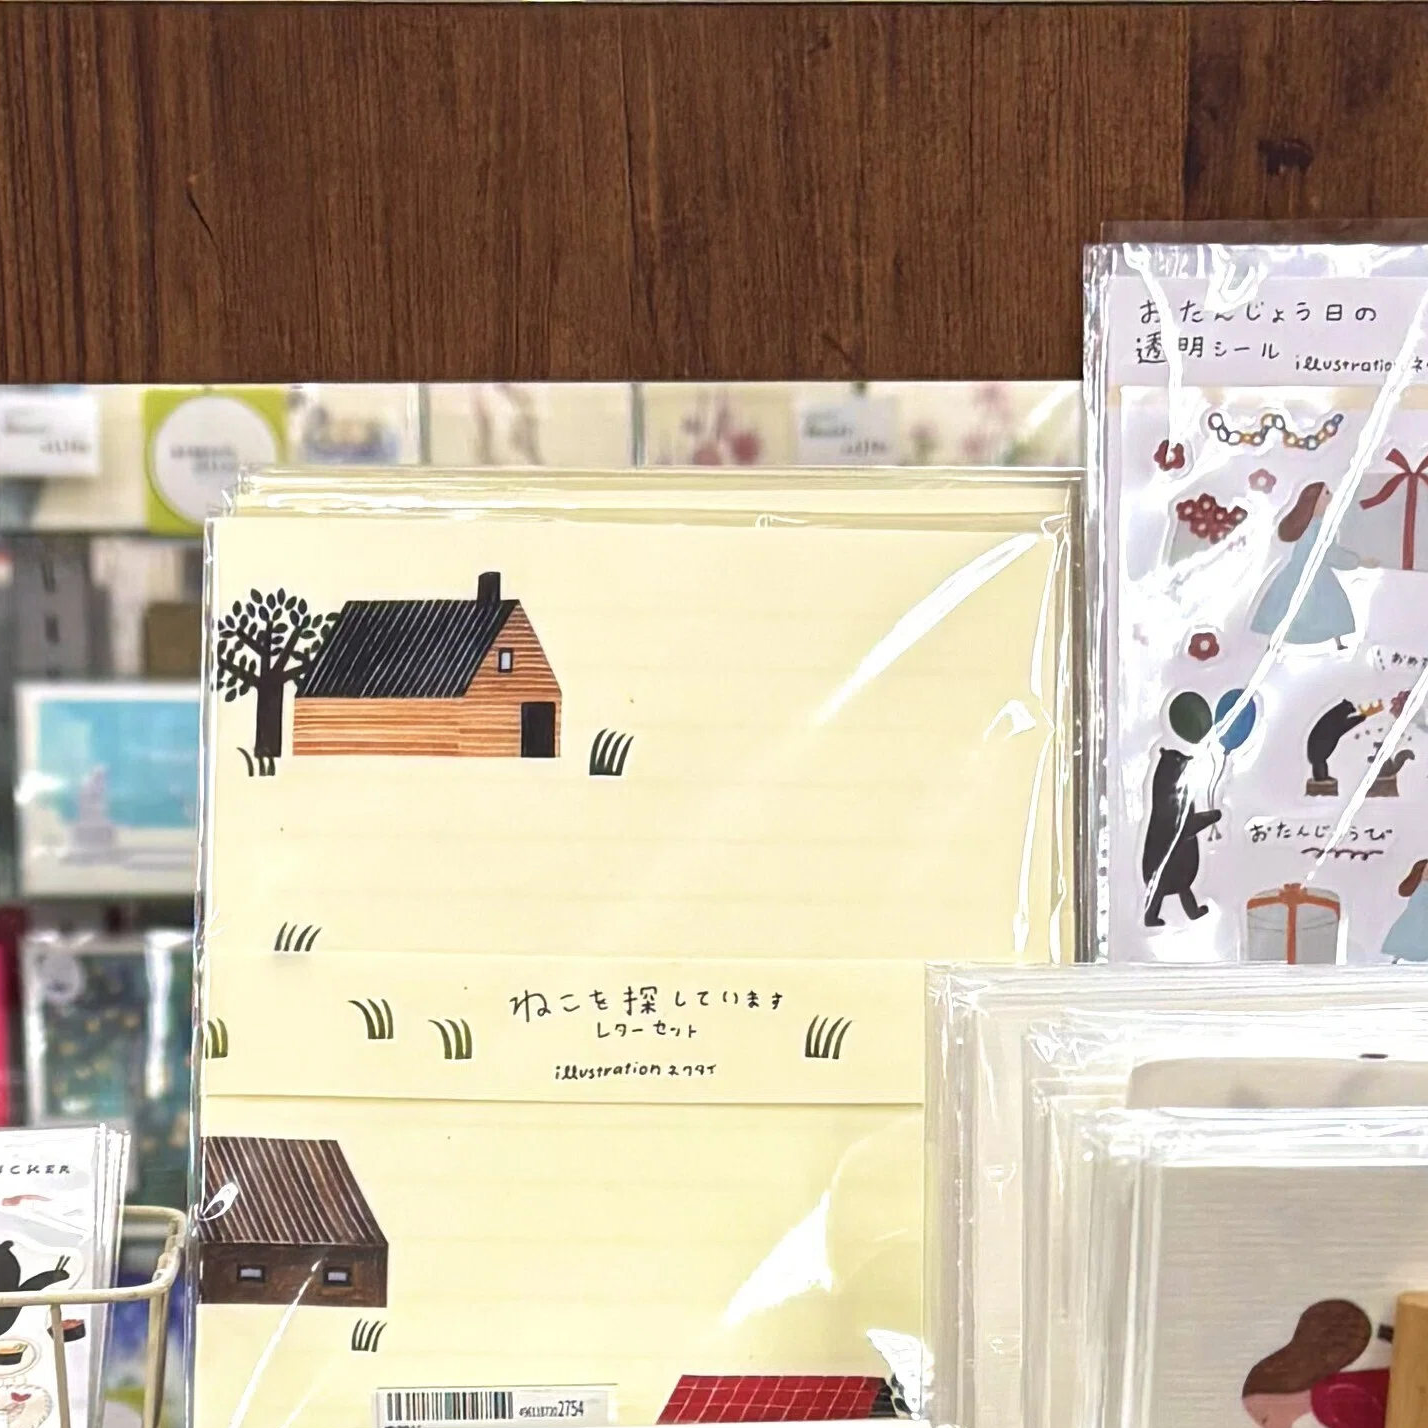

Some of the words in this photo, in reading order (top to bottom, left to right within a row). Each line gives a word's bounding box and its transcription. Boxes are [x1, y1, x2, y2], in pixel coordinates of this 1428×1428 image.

[509, 986, 783, 1023] ねこを探しています
[597, 1021, 697, 1039] レターセット
[555, 1061, 660, 1081] illustration
